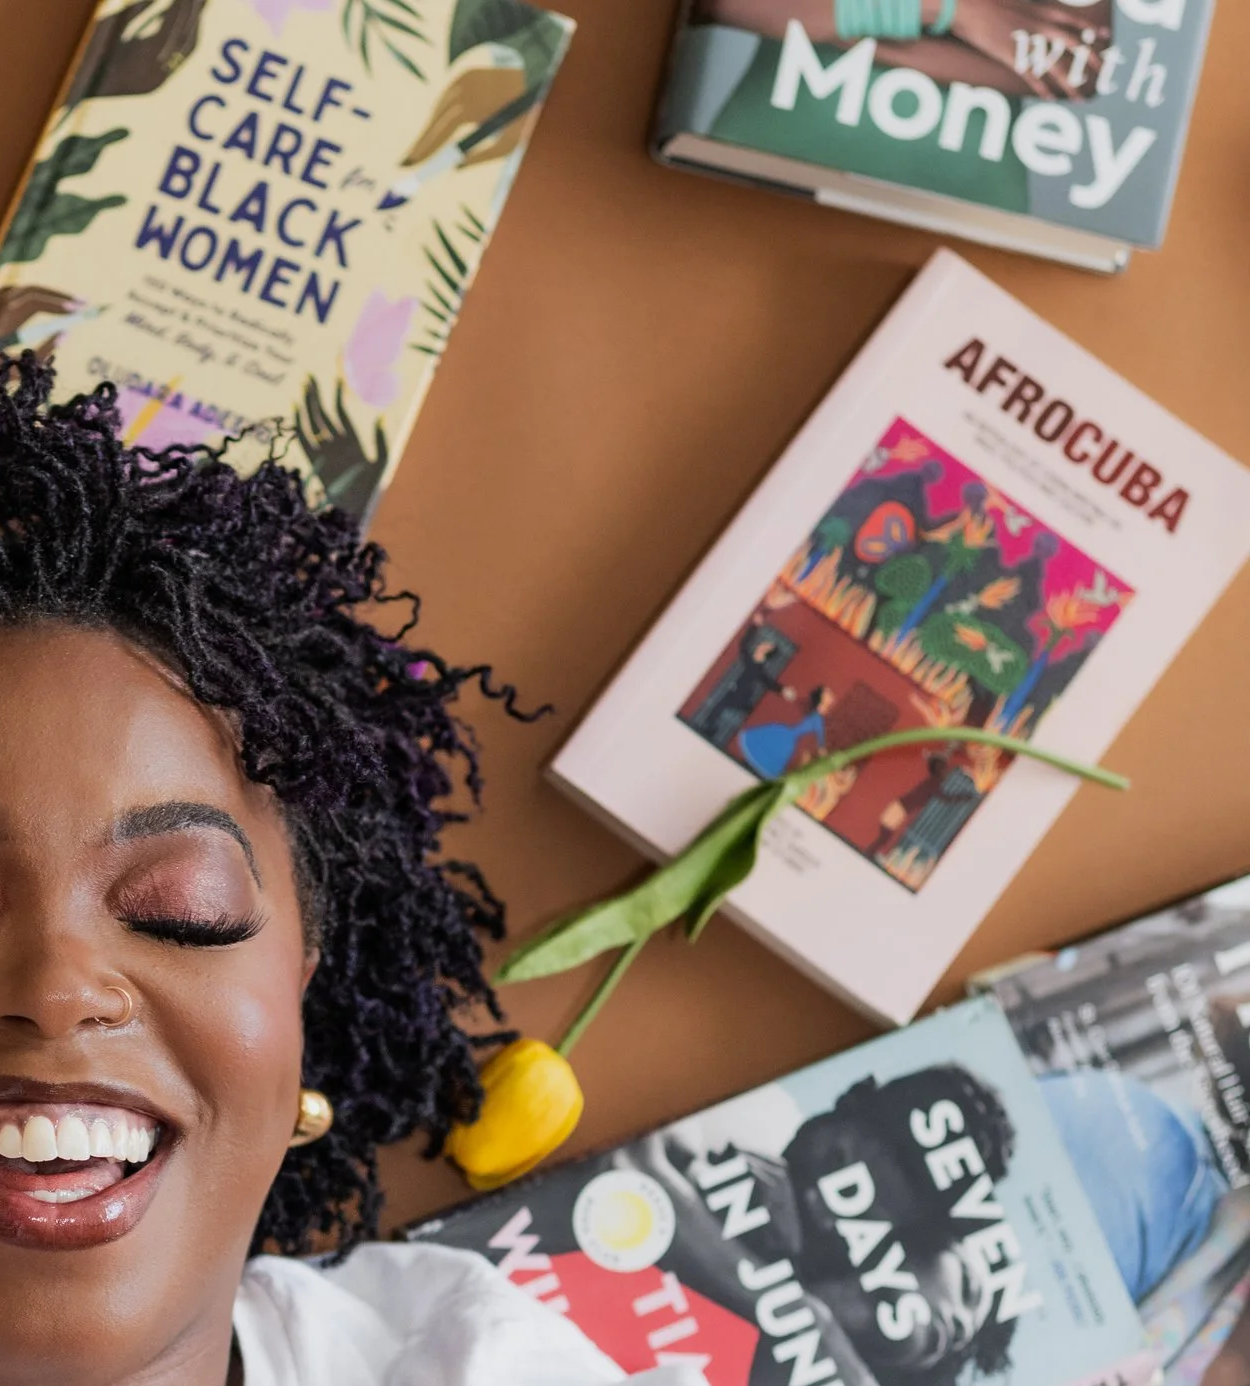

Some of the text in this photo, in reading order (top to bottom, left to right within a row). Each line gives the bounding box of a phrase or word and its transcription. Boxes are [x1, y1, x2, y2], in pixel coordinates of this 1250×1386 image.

[210, 37, 372, 123] SELF-
[770, 18, 1157, 209] Money
[1010, 27, 1169, 108] with
[188, 94, 342, 190] CARE
[134, 204, 342, 325] WOMEN
[158, 144, 365, 268] BLACK
[944, 337, 1193, 534] AFROCUBA
[699, 1154, 771, 1240] IN
[817, 1161, 931, 1340] DAYS
[910, 1099, 1044, 1324] SEVEN
